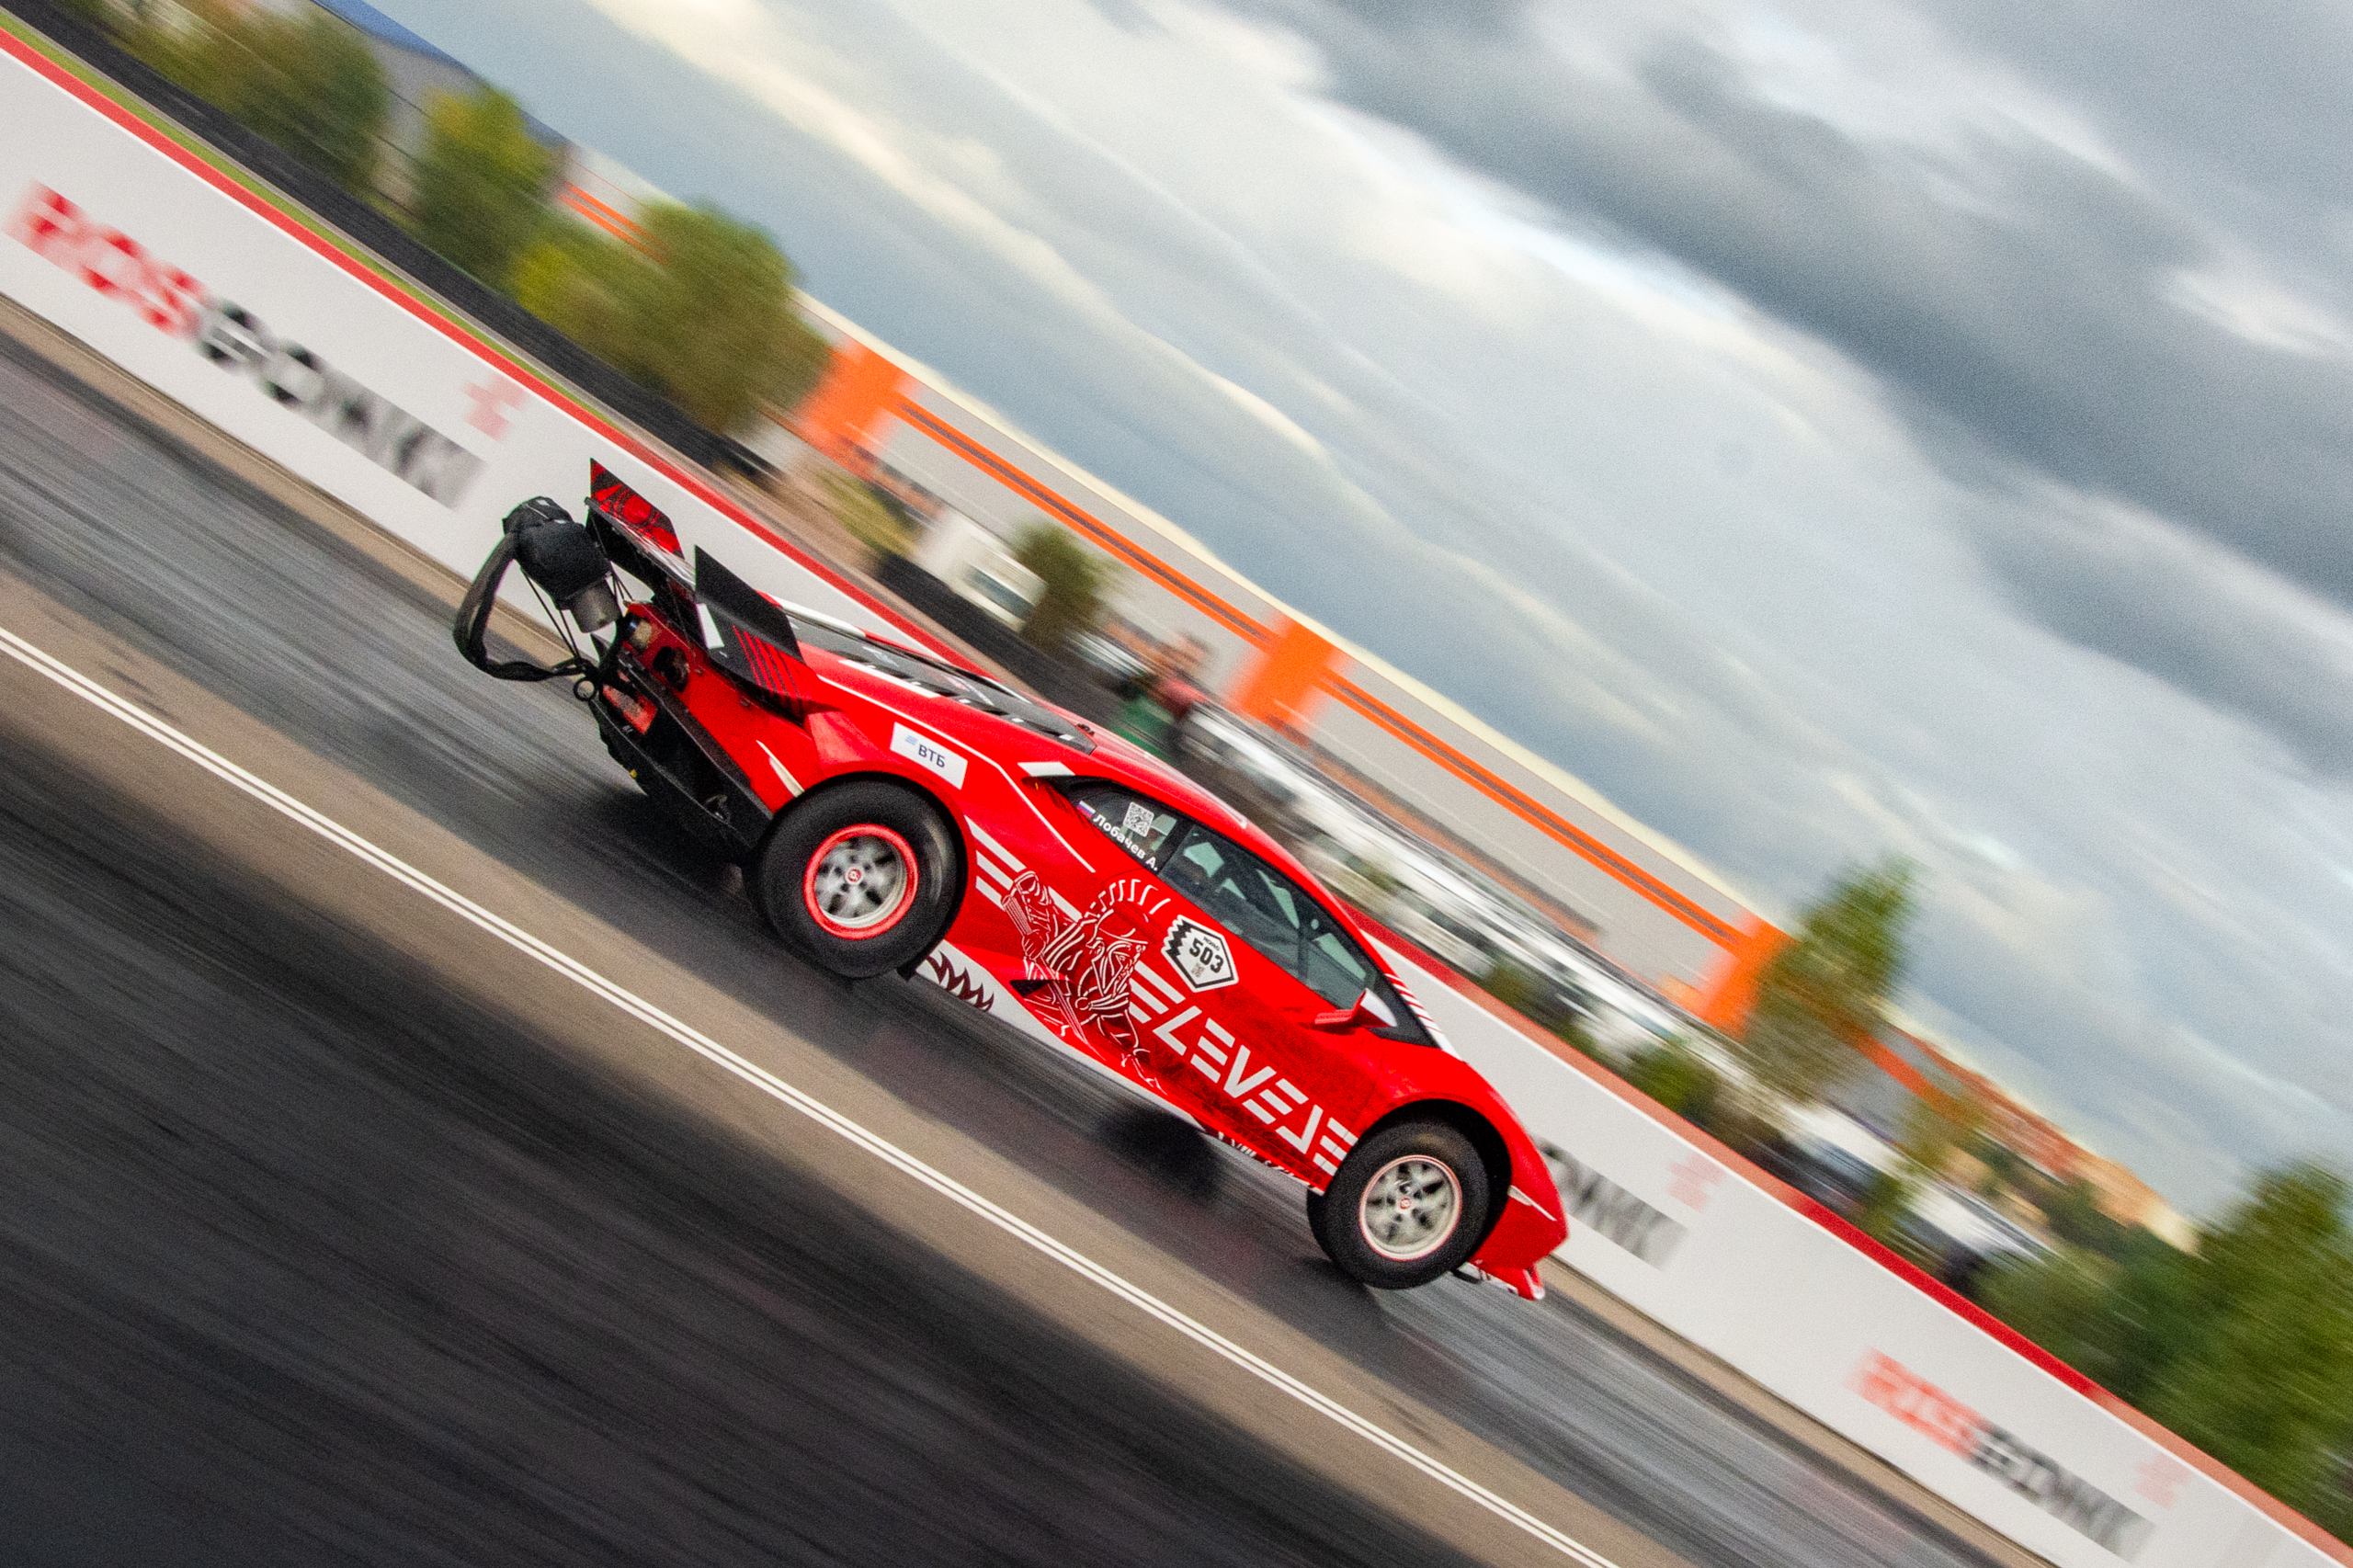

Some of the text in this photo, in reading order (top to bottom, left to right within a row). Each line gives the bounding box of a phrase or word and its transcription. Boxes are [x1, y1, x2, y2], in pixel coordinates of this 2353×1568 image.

[918, 744, 946, 768] ВТБ
[1092, 813, 1146, 859] Лобачев
[1188, 937, 1224, 973] 503
